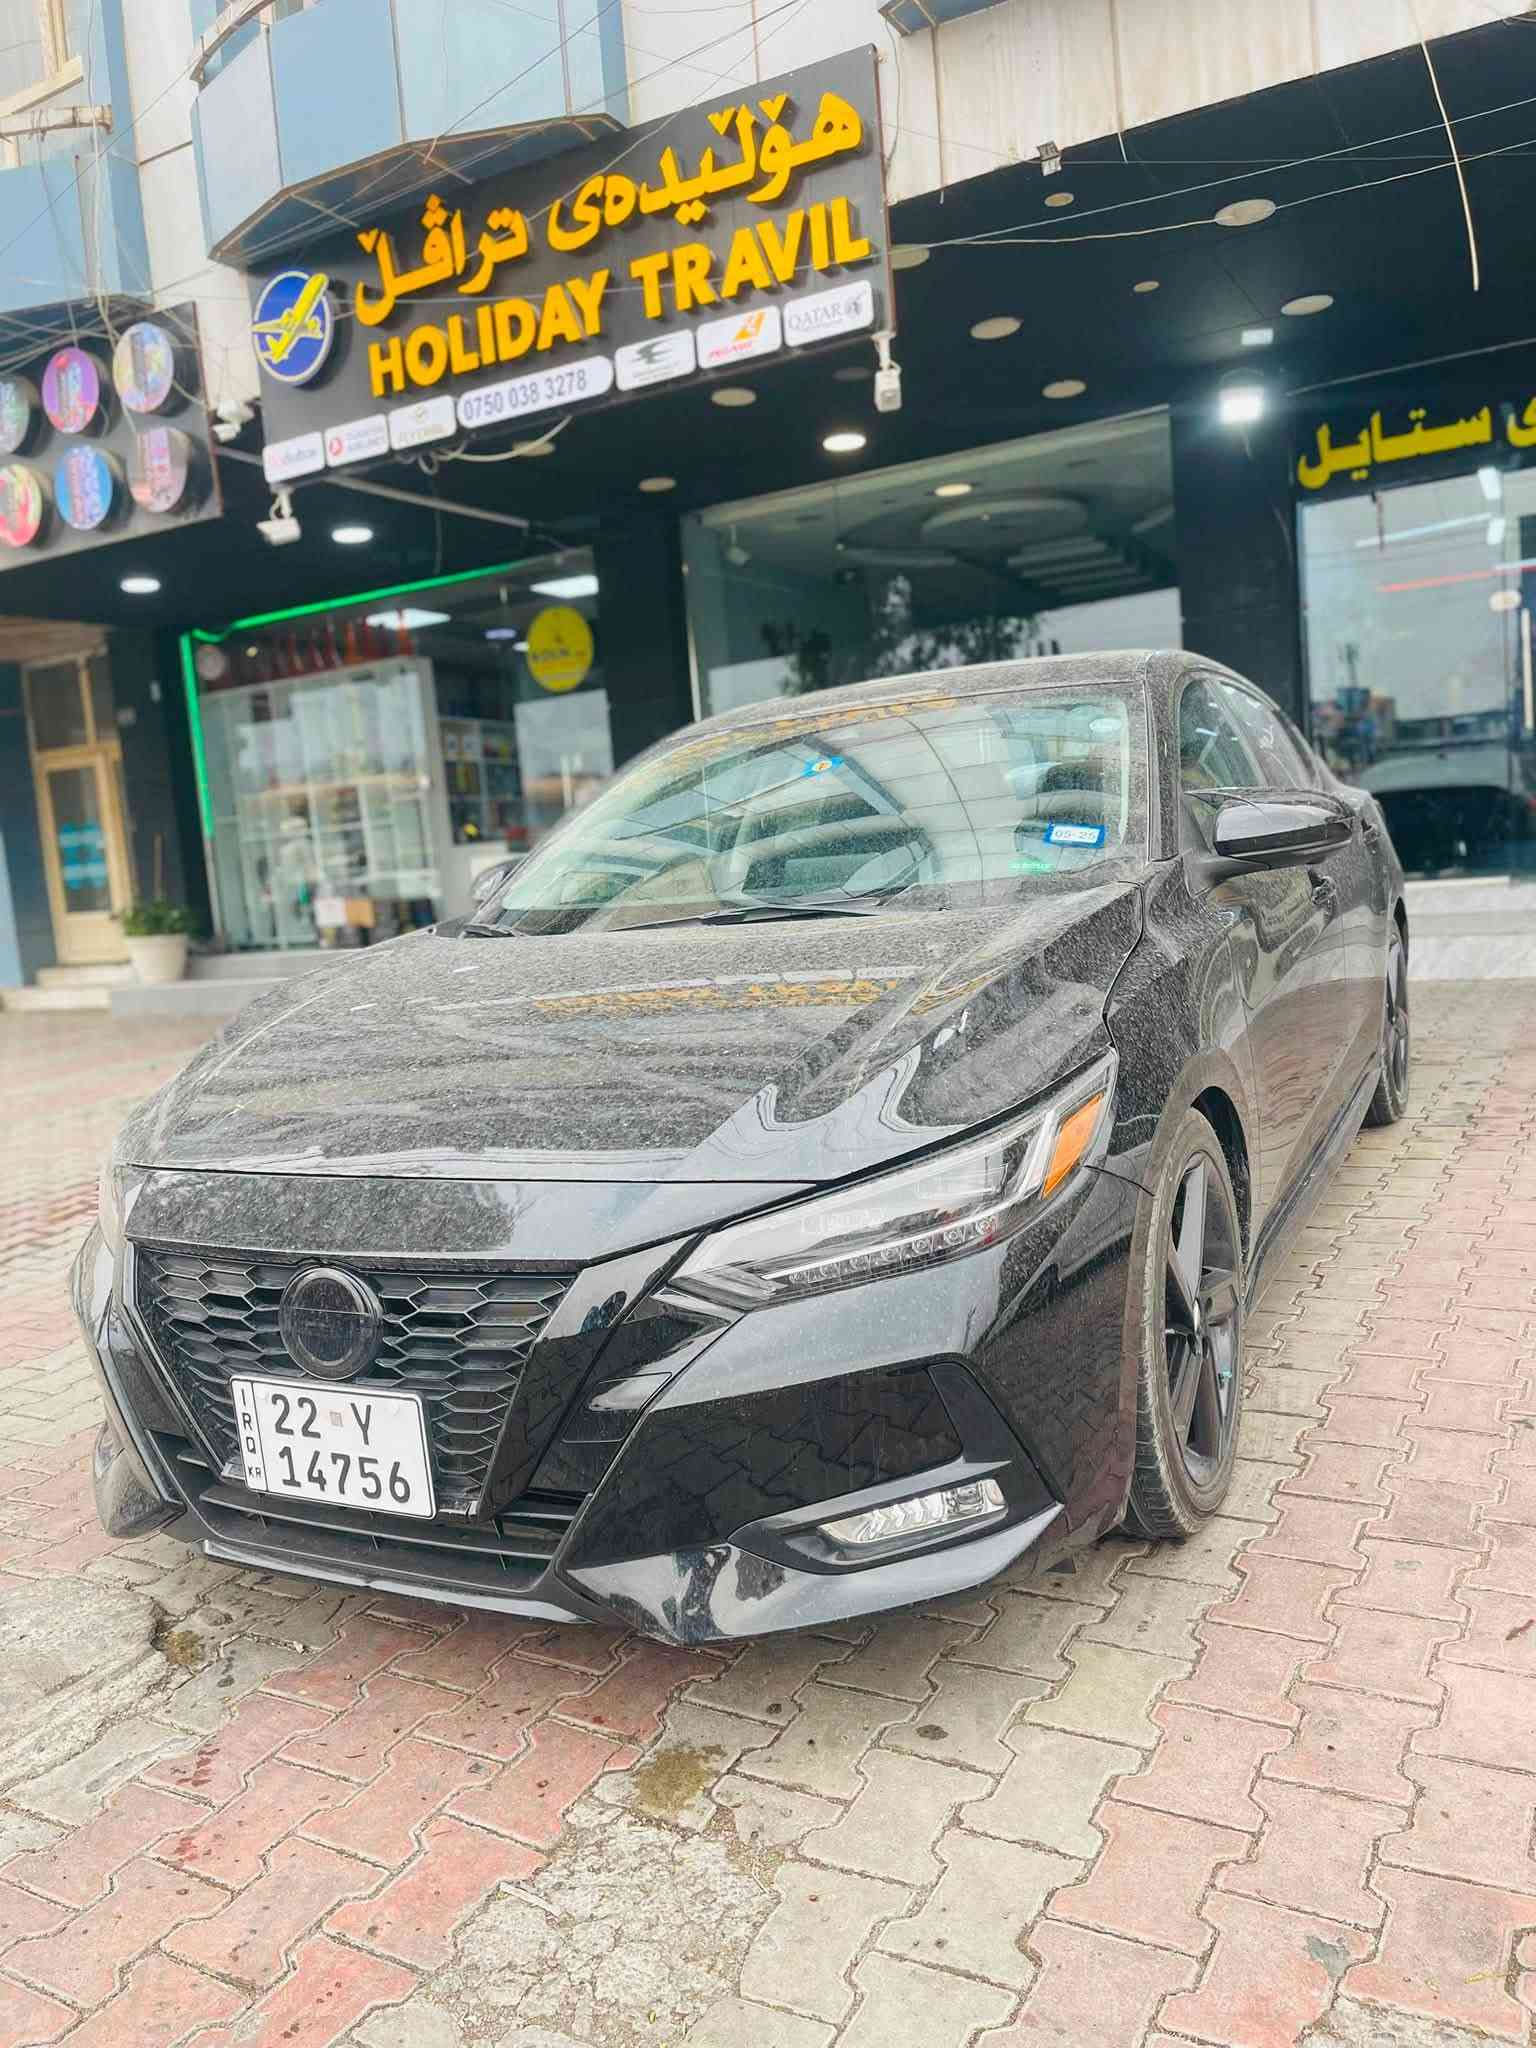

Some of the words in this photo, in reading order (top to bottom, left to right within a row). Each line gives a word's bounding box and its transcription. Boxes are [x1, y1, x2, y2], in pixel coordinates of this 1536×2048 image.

[367, 267, 611, 399] HOLIDAY
[629, 195, 871, 320] TRAVIL
[788, 300, 844, 331] QATAR
[463, 391, 503, 421] 0750
[509, 382, 540, 410] 038
[545, 369, 587, 399] 3278
[1297, 405, 1492, 490] ستایل
[271, 1394, 321, 1438] 22
[350, 1402, 372, 1445] Y
[247, 1465, 262, 1478] KR
[278, 1446, 411, 1503] 14756
